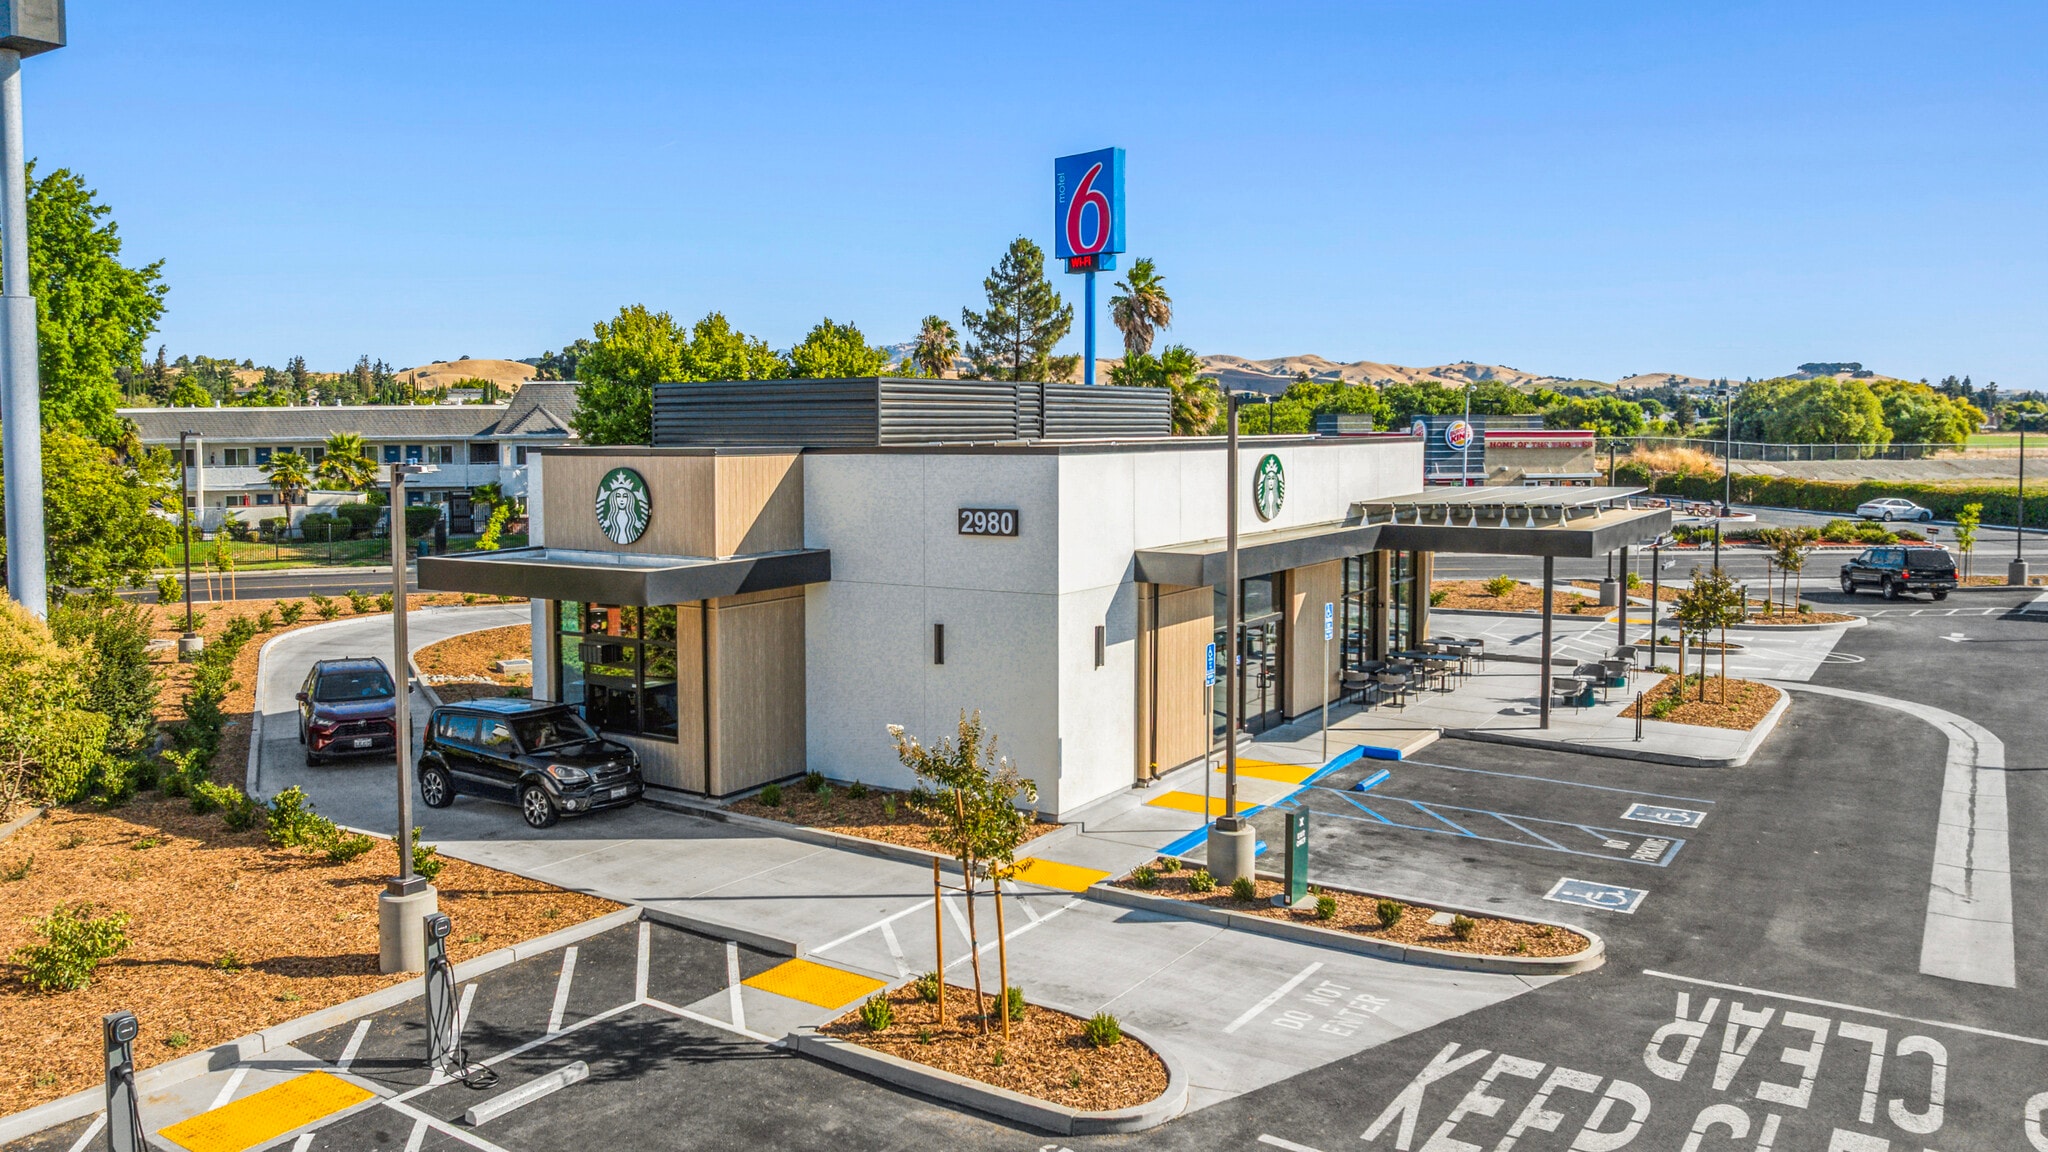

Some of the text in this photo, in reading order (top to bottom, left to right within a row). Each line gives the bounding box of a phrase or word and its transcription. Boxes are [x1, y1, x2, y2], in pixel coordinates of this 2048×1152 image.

[1057, 172, 1066, 204] motel
[1066, 162, 1111, 255] 6
[961, 511, 1013, 534] 2980
[1271, 980, 1351, 1030] DO NOT
[1319, 993, 1390, 1037] ENTER
[1642, 991, 1948, 1135] CLEAR
